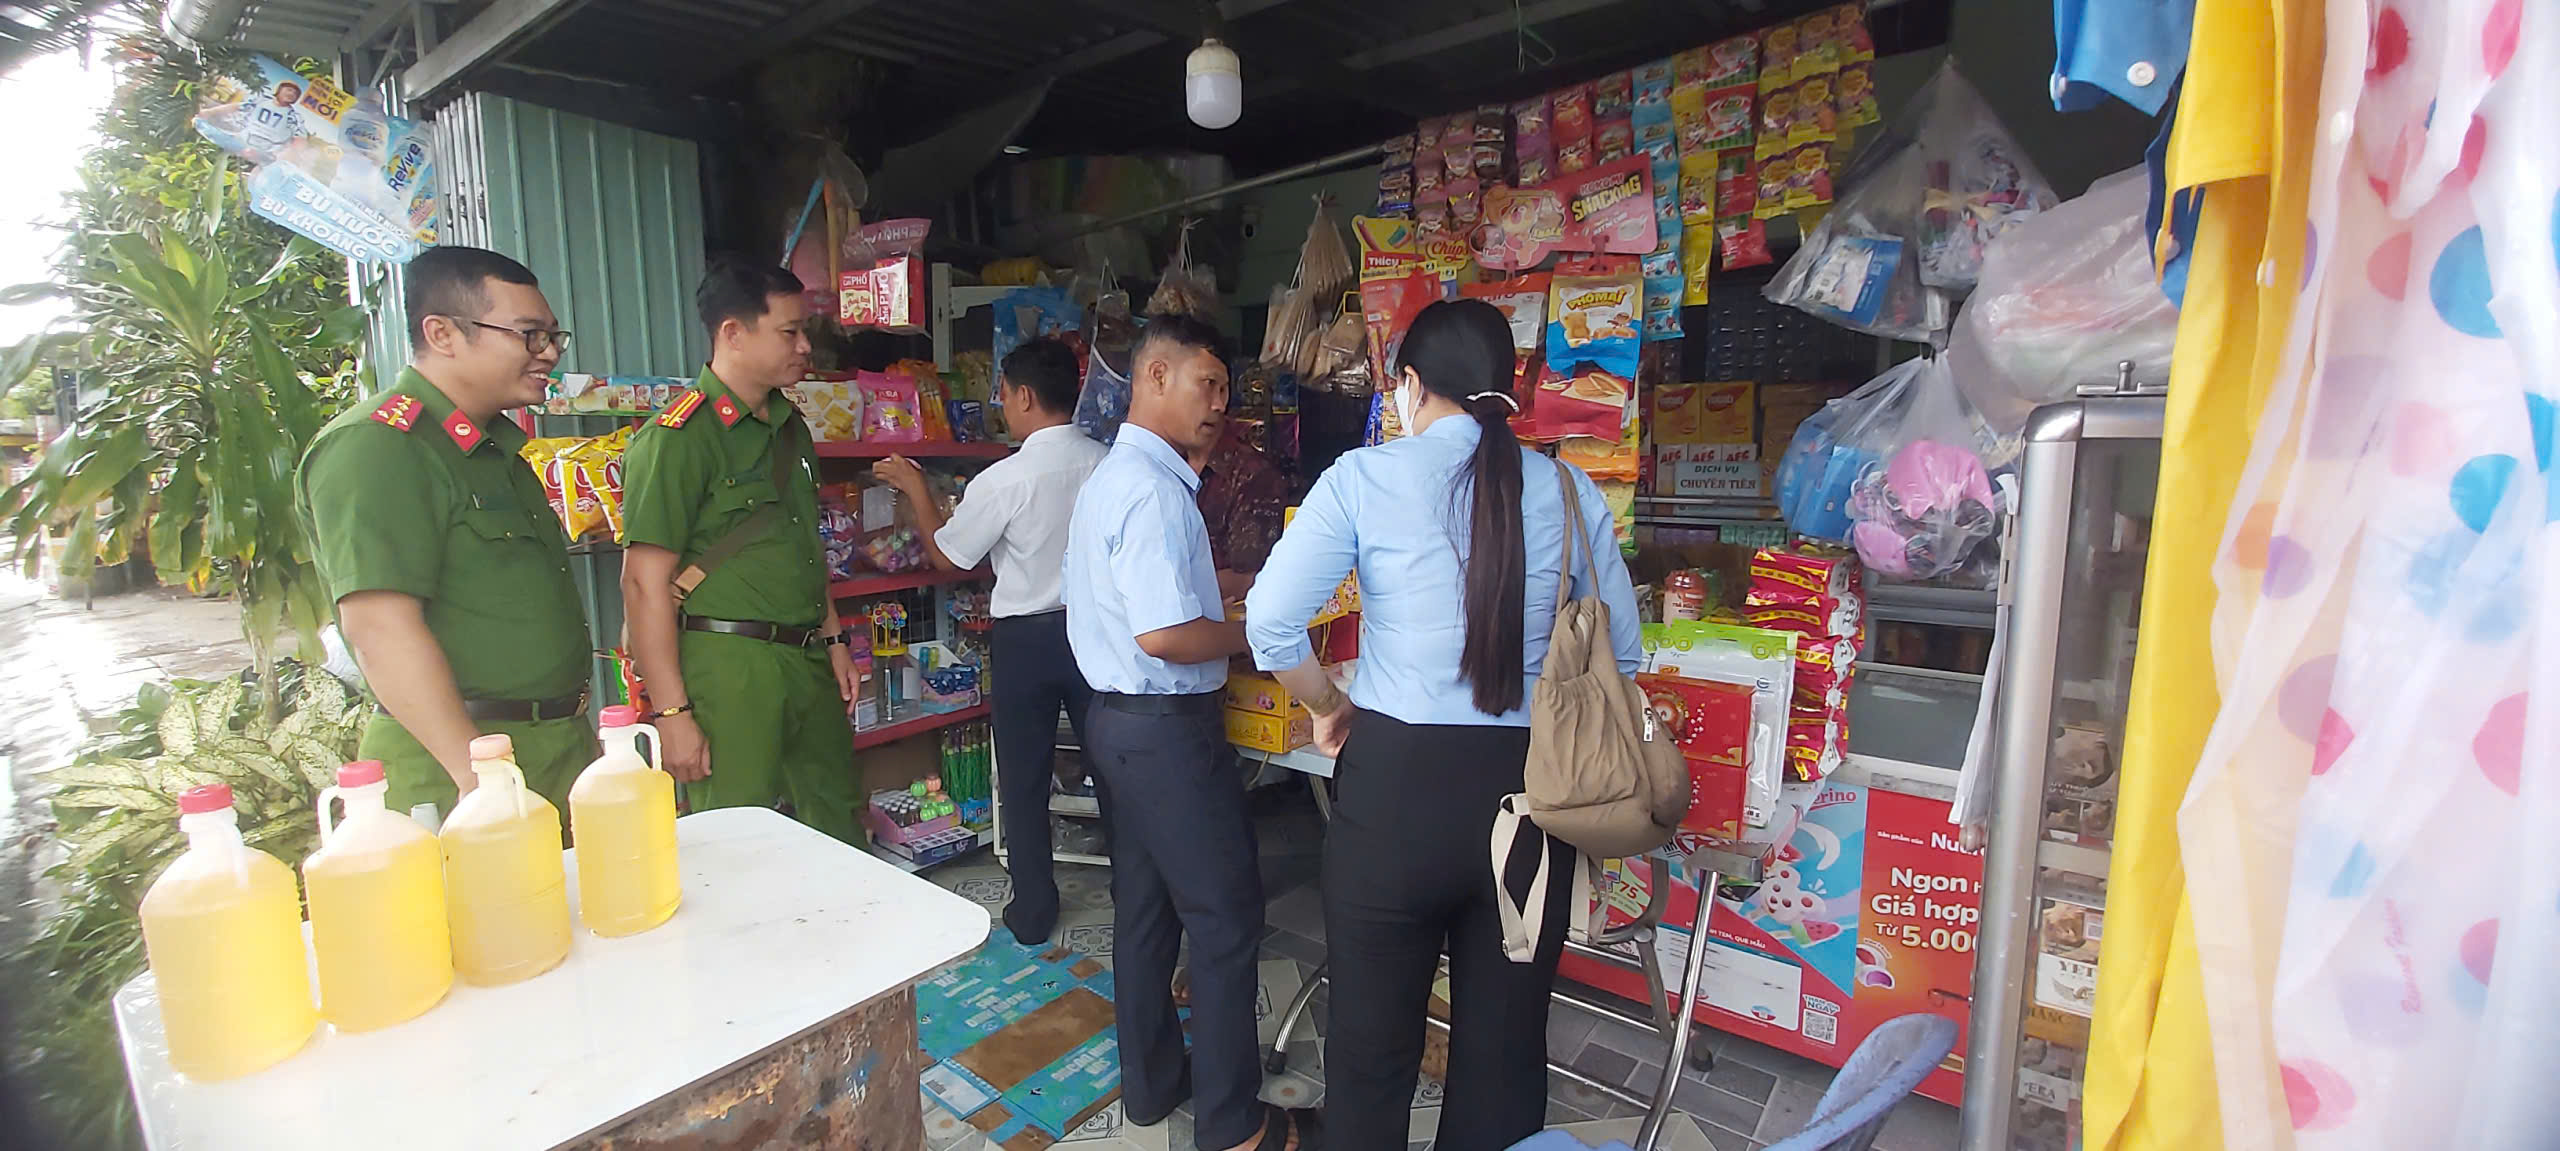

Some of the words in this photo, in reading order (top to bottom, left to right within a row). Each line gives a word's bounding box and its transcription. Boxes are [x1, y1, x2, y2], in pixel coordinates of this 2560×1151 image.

[257, 107, 283, 128] 07
[1571, 175, 1641, 222] SNACKING
[259, 196, 289, 217] BÙ
[288, 210, 368, 259] KHOÁNG
[1695, 465, 1720, 474] DỊCH
[1725, 465, 1740, 474] VỤ
[1818, 788, 1857, 802] rino
[1890, 866, 1968, 894] Ngon
[1619, 881, 1638, 899] 75
[1871, 893, 1916, 917] Giá
[1923, 898, 1979, 926] hợp
[1874, 922, 1898, 936] Từ
[1807, 1001, 1836, 1015] NGAY
